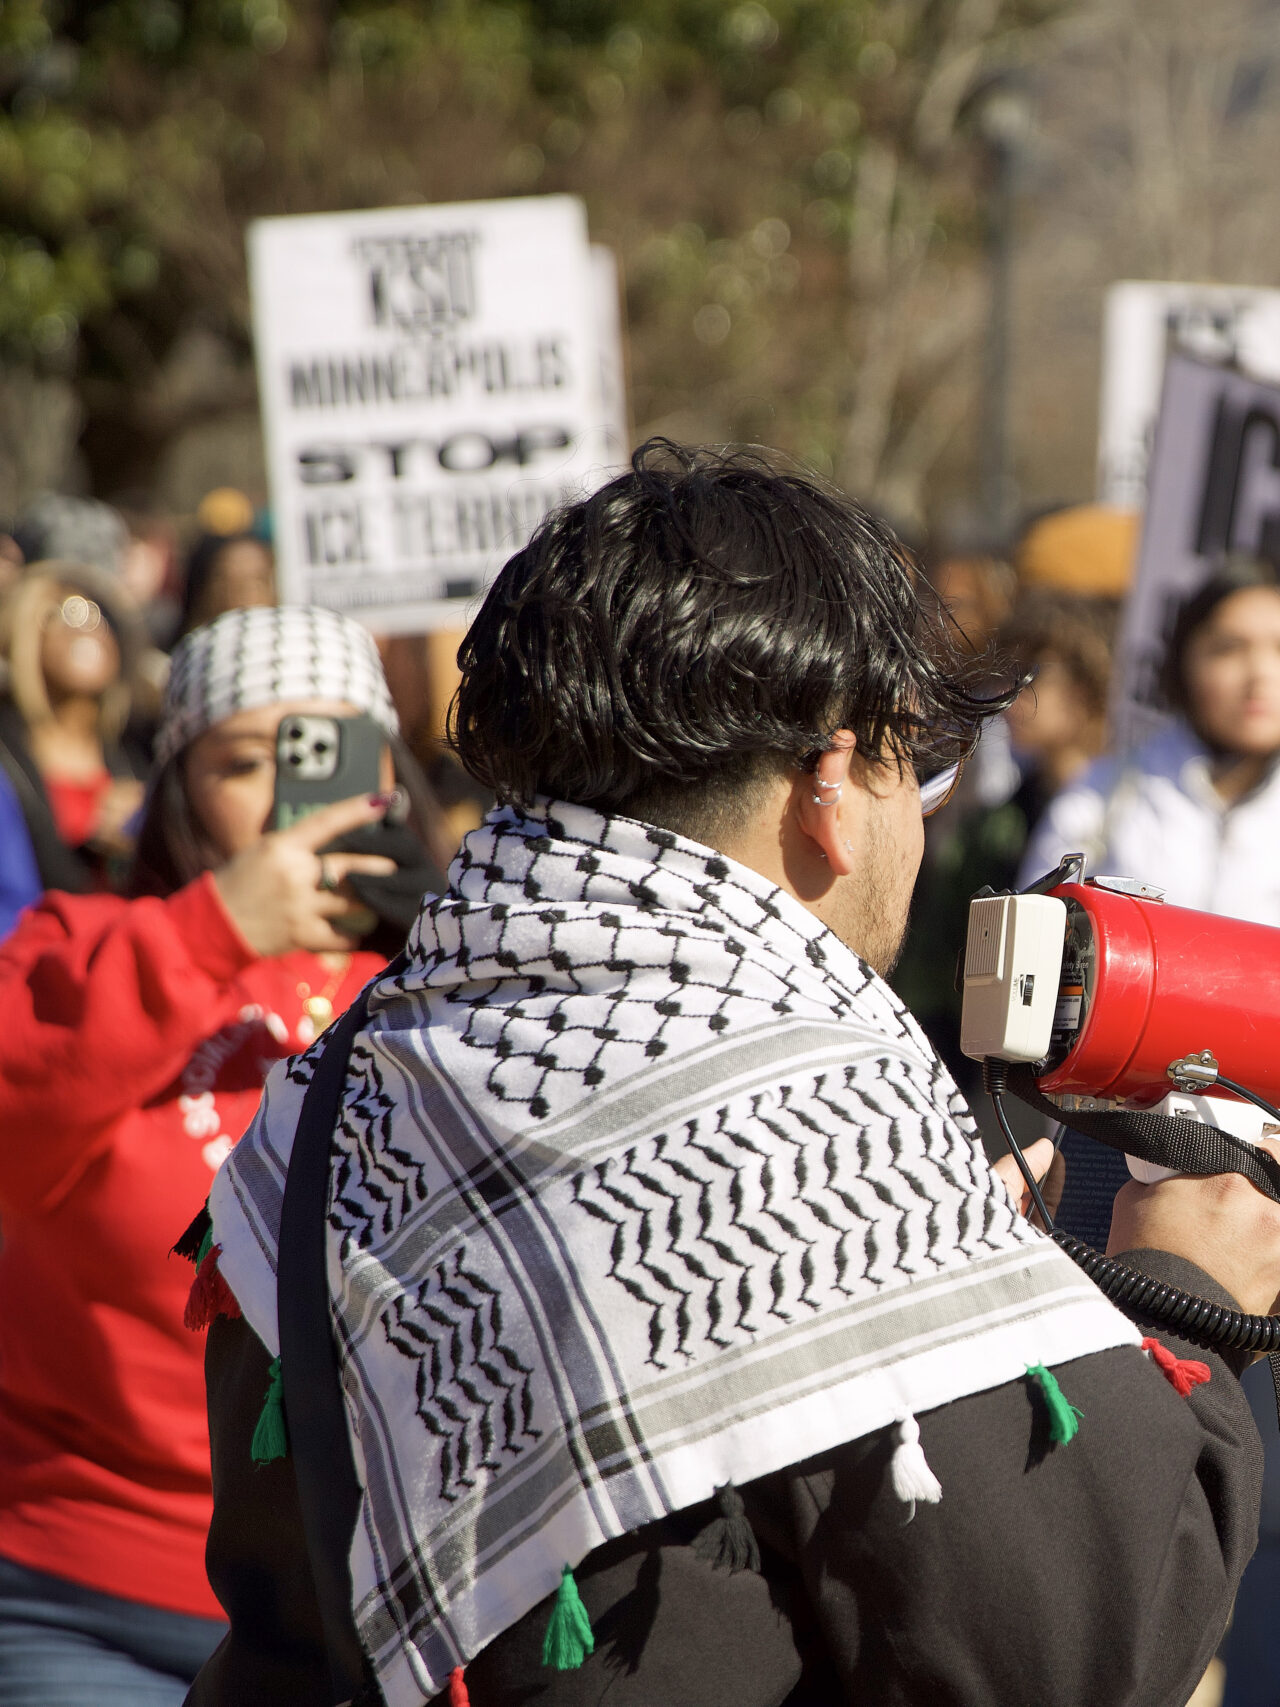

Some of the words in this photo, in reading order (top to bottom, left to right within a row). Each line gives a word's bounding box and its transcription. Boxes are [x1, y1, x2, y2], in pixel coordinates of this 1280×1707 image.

[286, 334, 572, 408] MINNEAPOLIS
[298, 424, 573, 484] STOP
[304, 498, 368, 566] ICE
